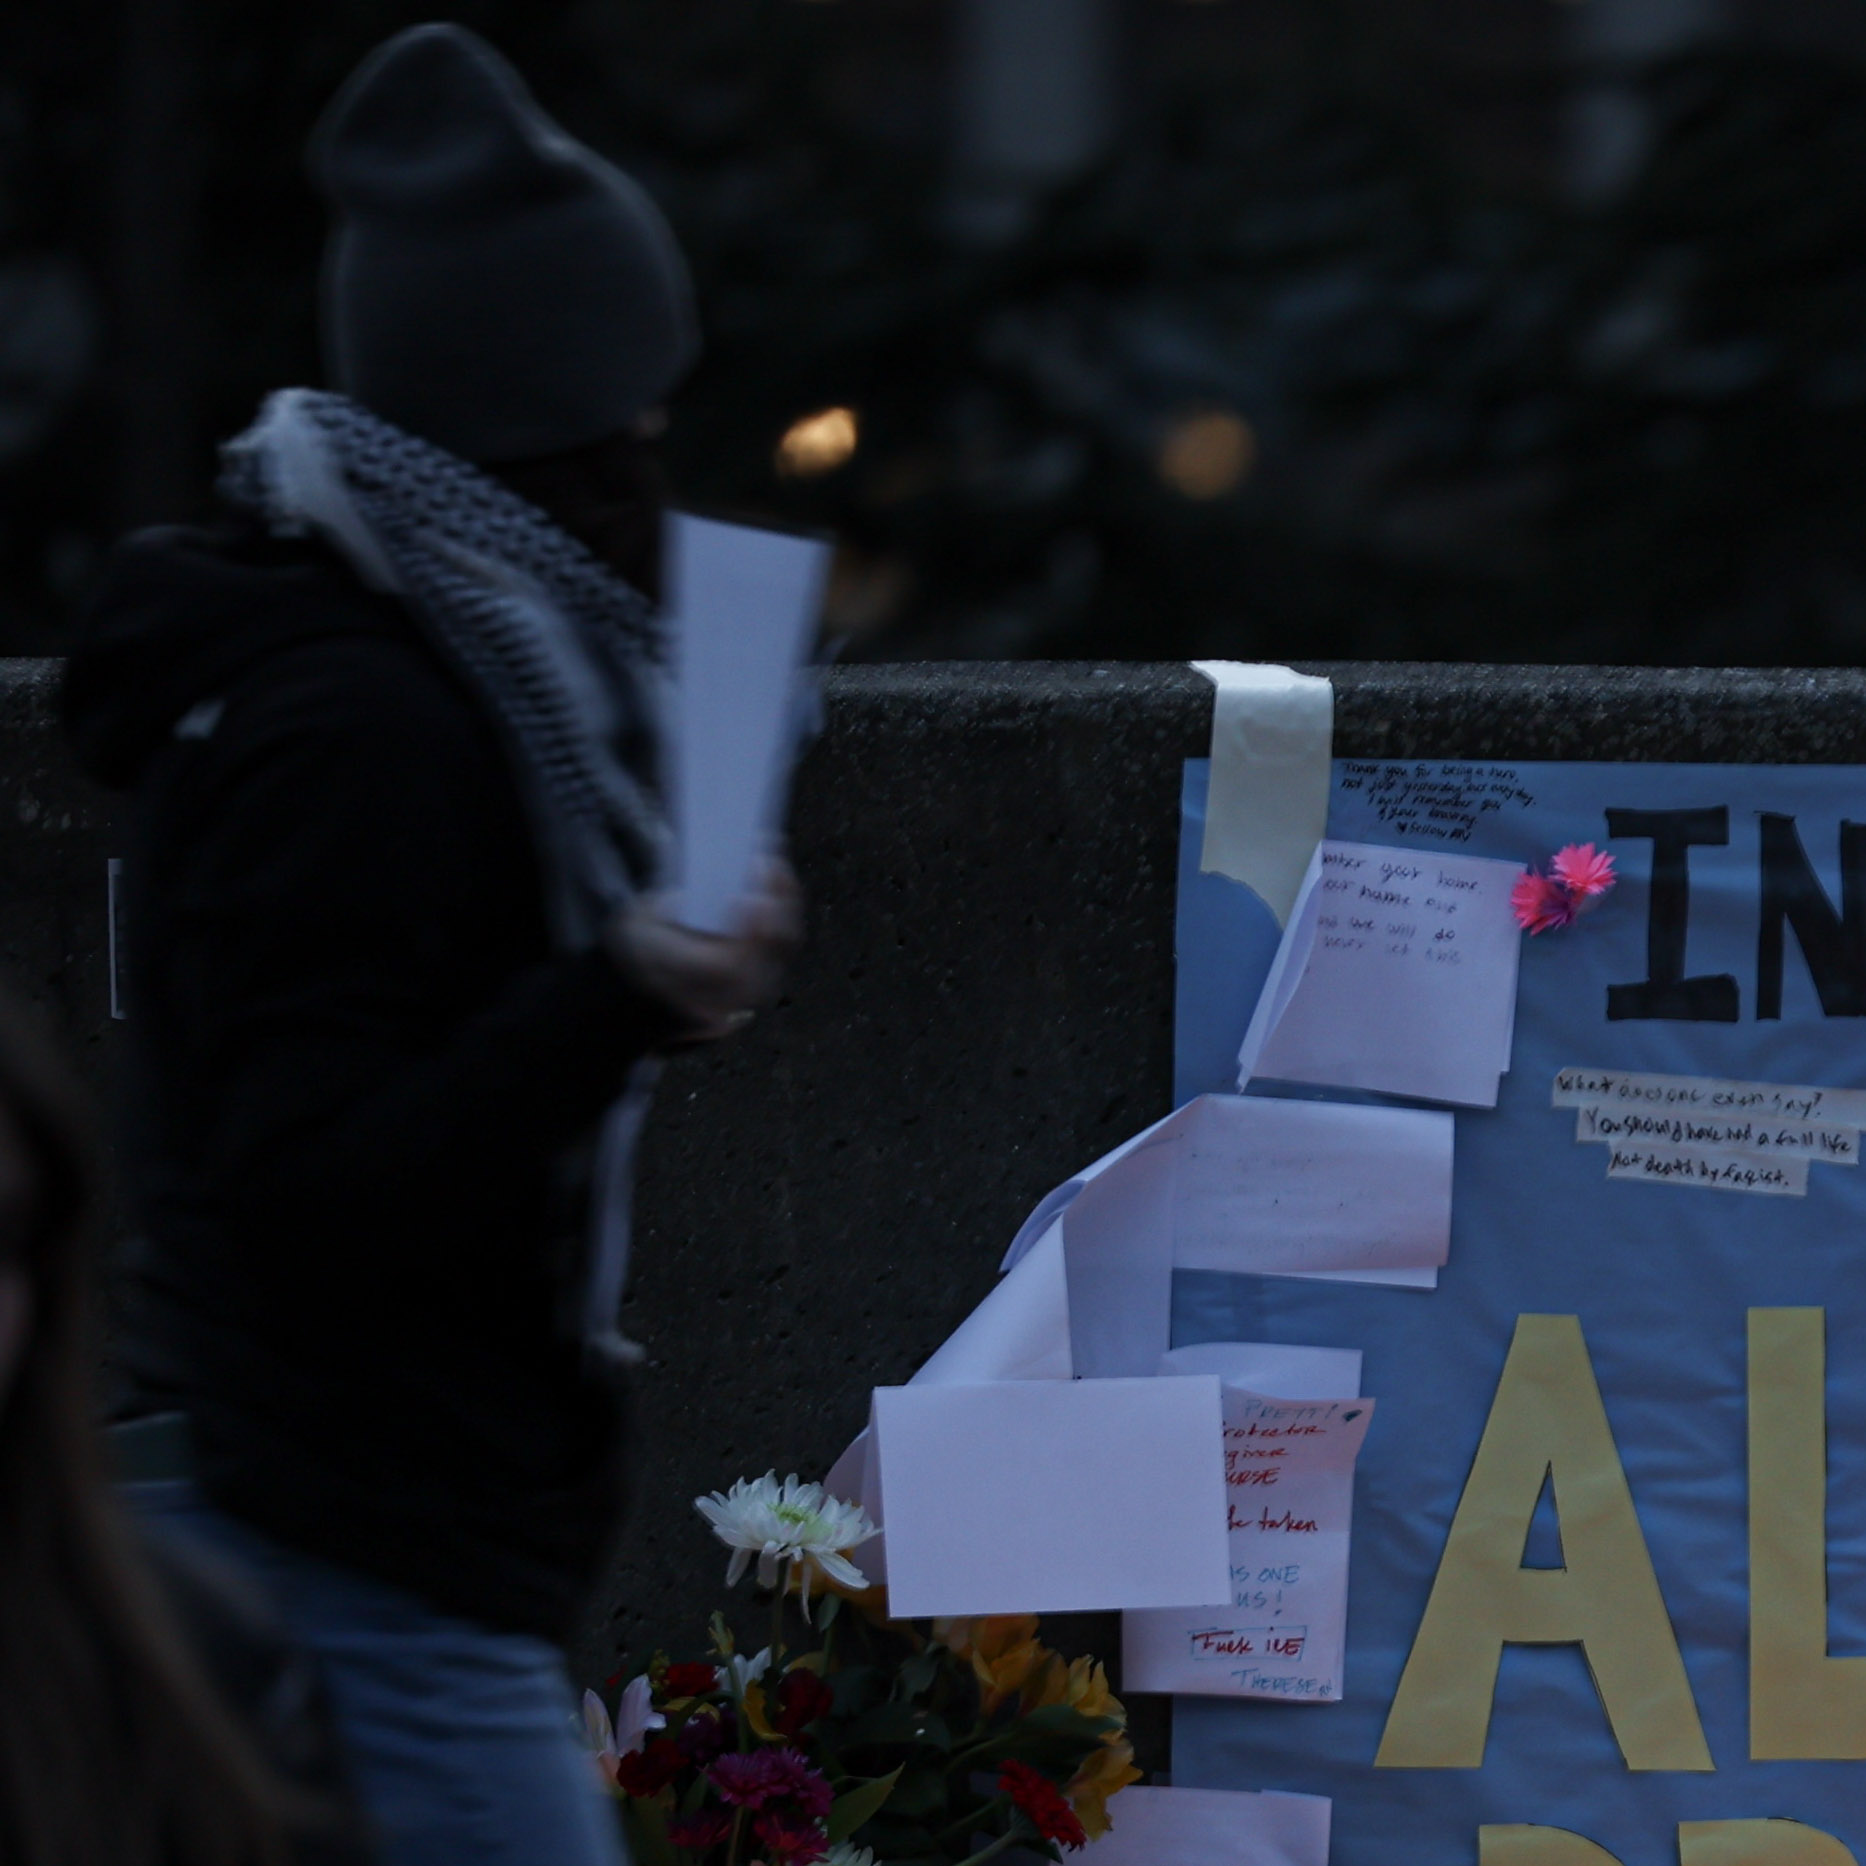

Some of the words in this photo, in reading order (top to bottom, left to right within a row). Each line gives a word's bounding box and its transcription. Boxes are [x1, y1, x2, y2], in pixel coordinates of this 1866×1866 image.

[1386, 766, 1407, 783] you
[1758, 1131, 1770, 1146] a
[1822, 1131, 1852, 1153] life
[1645, 1156, 1694, 1177] death
[1259, 1508, 1318, 1532] taken
[1258, 1564, 1300, 1582] ONE
